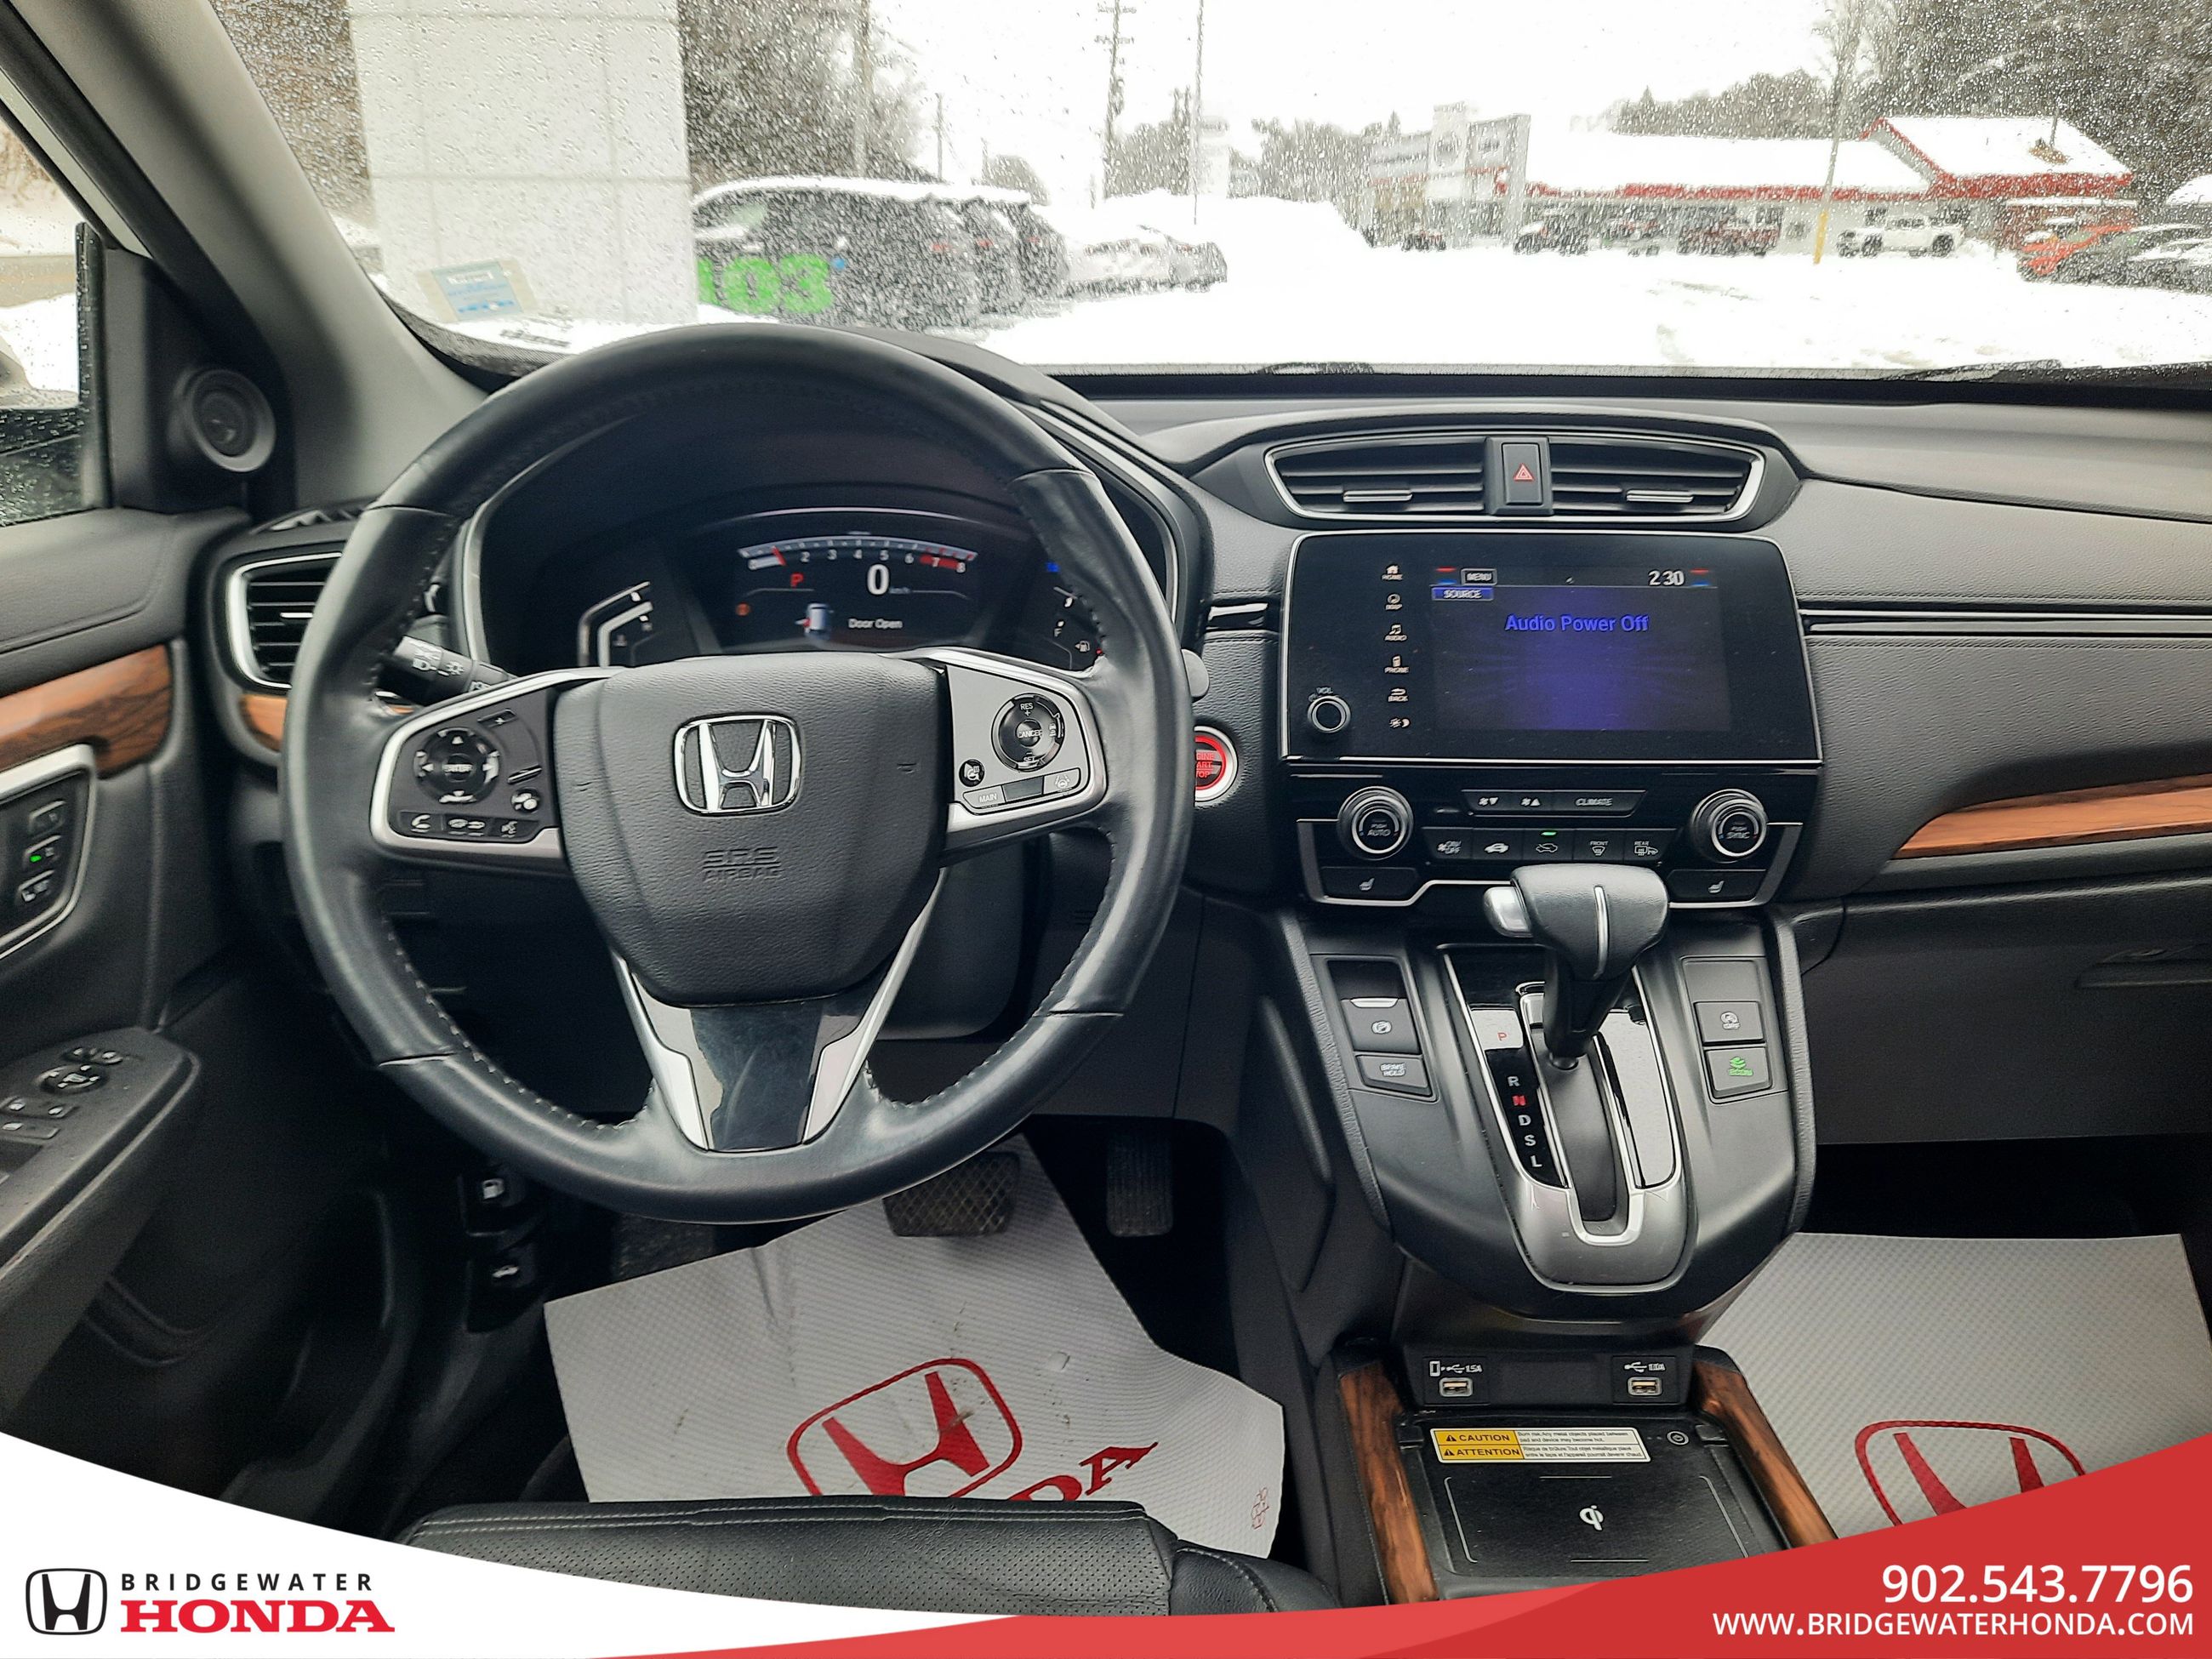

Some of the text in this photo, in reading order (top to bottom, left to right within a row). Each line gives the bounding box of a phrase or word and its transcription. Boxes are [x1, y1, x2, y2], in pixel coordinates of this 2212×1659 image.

[790, 573, 804, 587] P
[867, 563, 890, 595] 0
[848, 618, 903, 629] Door Open
[1505, 614, 1649, 631] Audio Power Off
[978, 794, 998, 802] MAIN
[1576, 798, 1612, 807] CLIMATE
[1497, 1032, 1507, 1040] P
[1508, 1076, 1520, 1086] R
[1518, 1115, 1531, 1126] D
[1525, 1135, 1536, 1146] S
[1531, 1155, 1542, 1167] L
